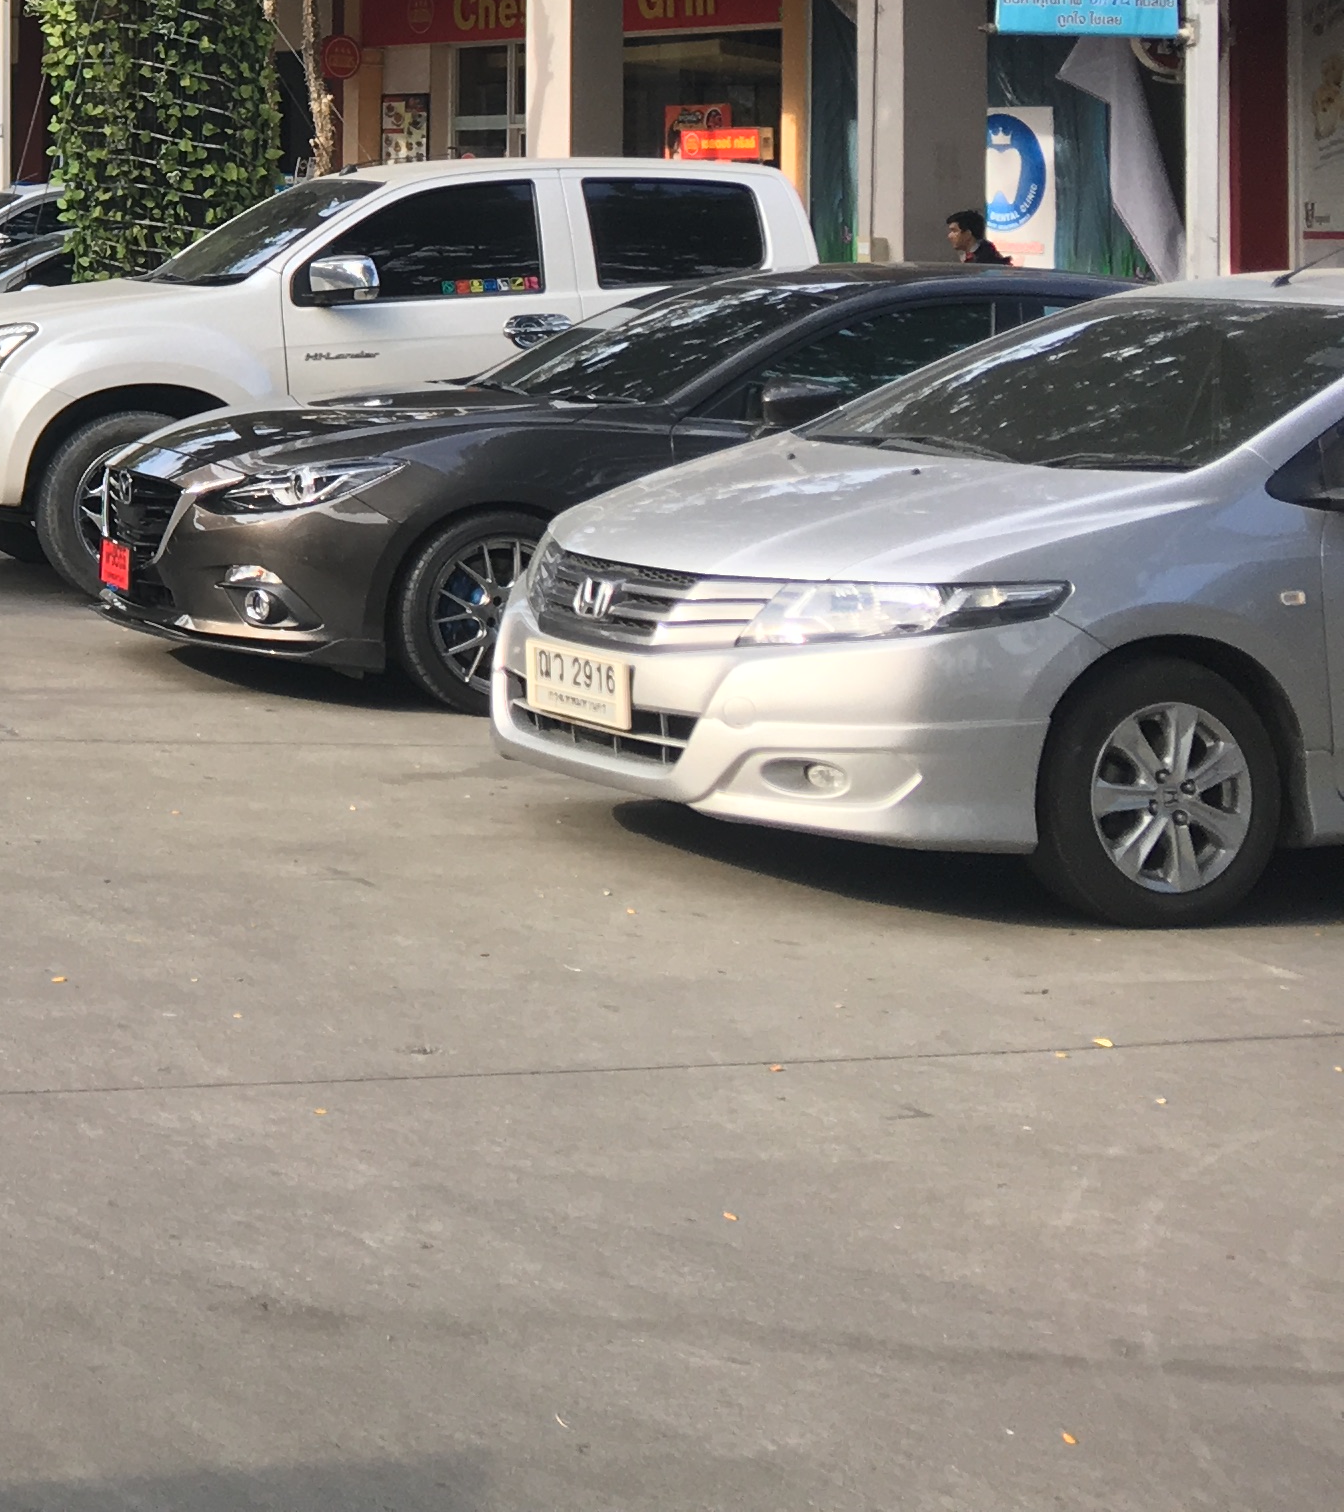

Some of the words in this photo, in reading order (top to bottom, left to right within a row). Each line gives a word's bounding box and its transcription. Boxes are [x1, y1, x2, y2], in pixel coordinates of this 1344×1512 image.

[1019, 183, 1038, 213] CLINIC
[989, 210, 1021, 222] DENTAL
[571, 656, 616, 695] 2916
